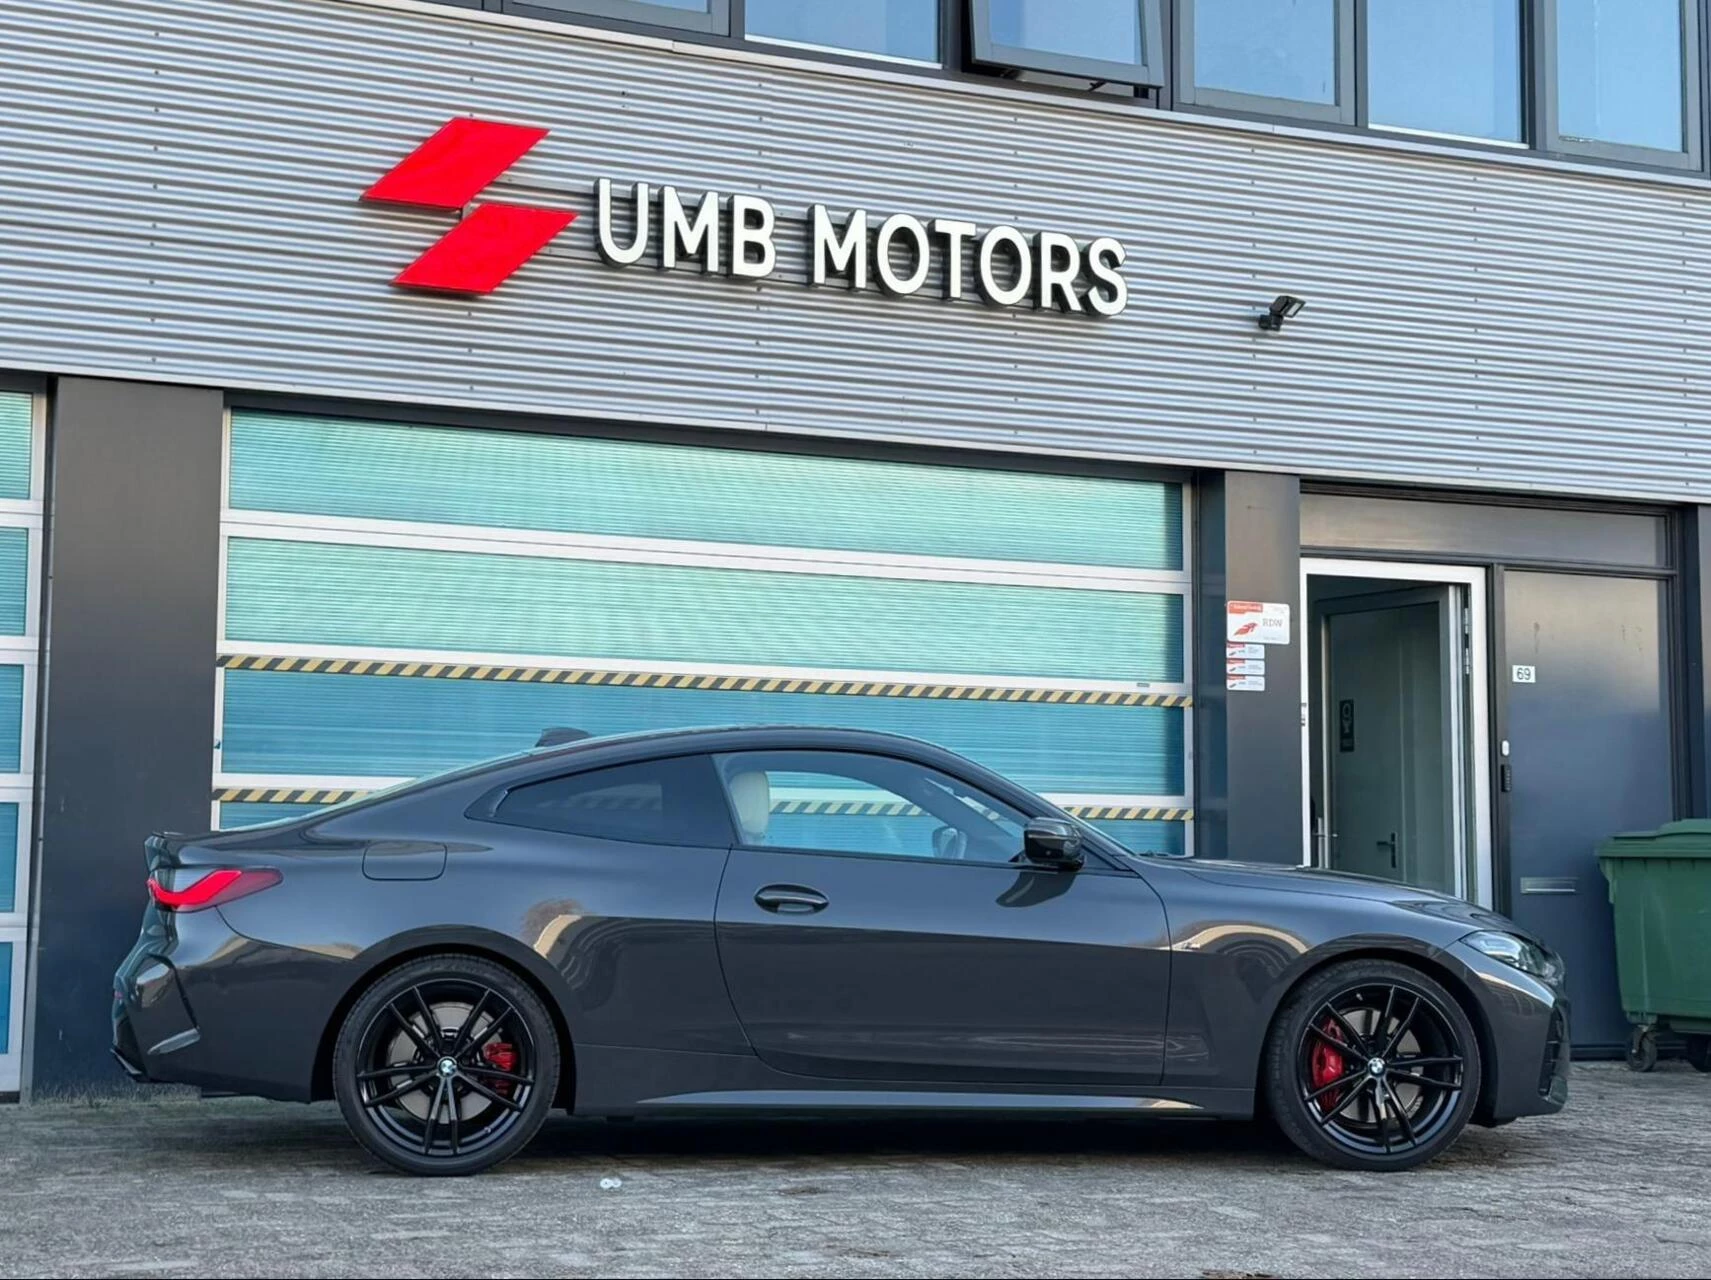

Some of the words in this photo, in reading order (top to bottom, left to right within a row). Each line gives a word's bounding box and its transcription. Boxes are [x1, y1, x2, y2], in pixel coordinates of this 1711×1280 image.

[595, 177, 777, 279] UMB
[809, 203, 1129, 317] MOTORS
[1516, 667, 1531, 681] 69
